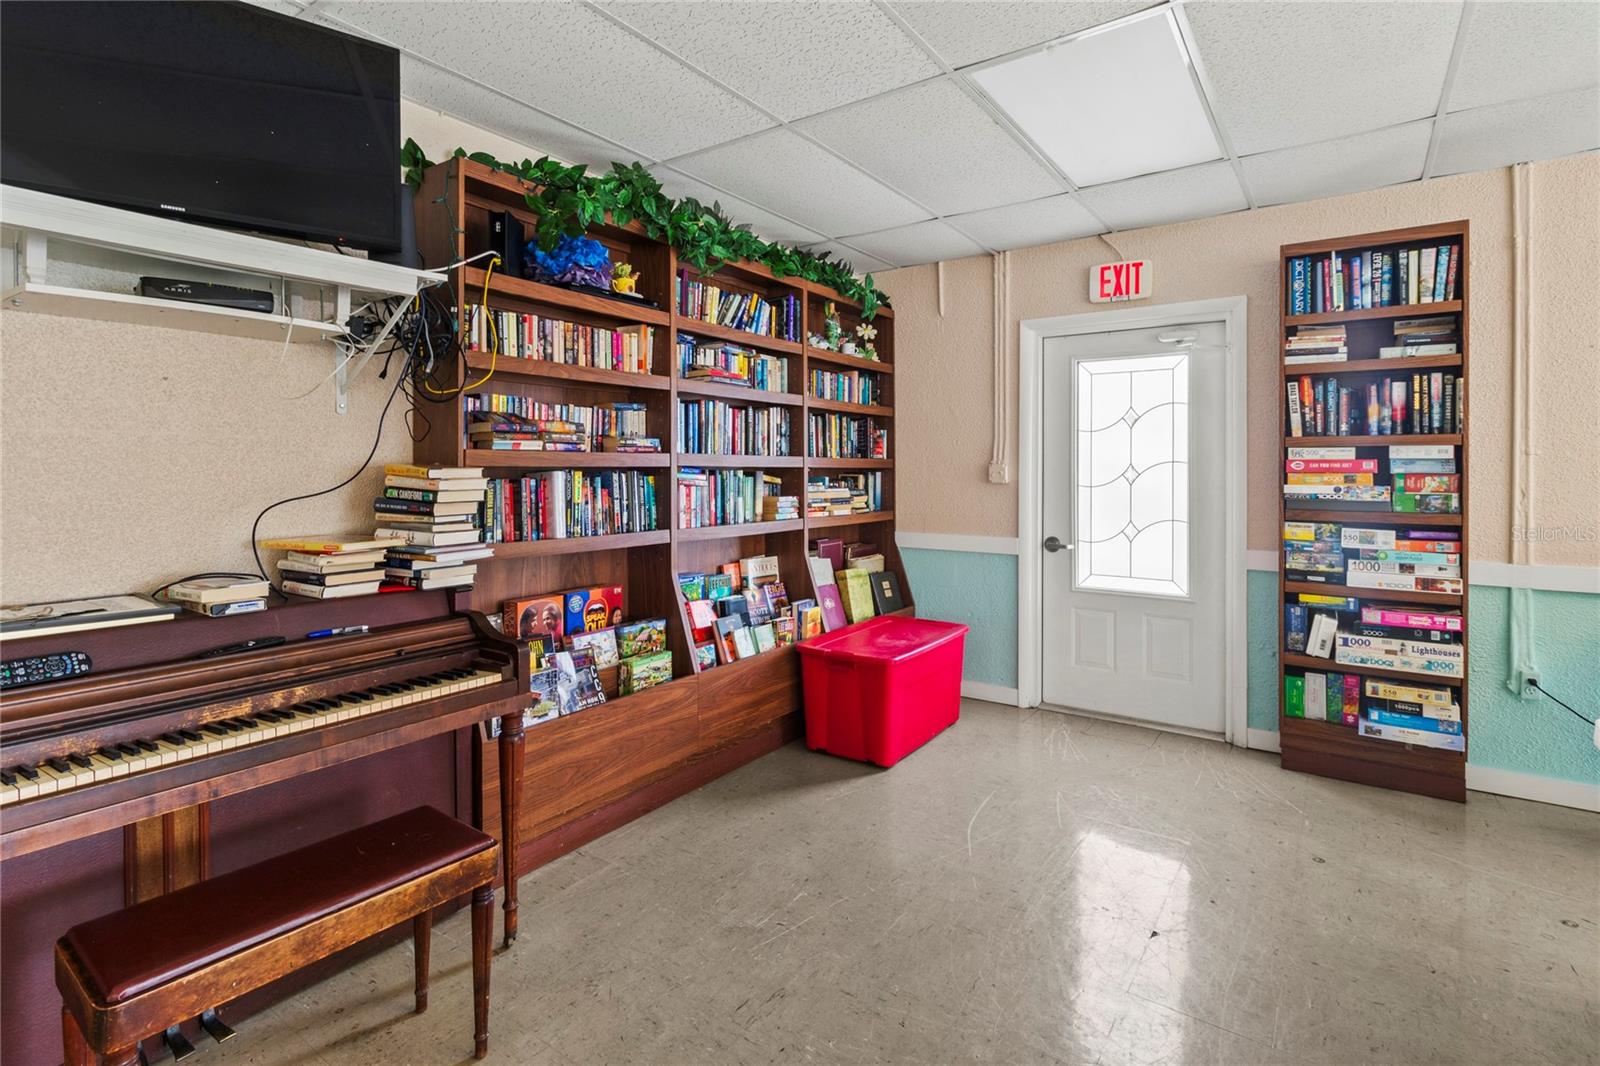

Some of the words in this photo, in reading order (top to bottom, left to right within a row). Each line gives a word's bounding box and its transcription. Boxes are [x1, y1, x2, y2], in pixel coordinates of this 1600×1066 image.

[1100, 261, 1143, 298] EXIT
[1293, 259, 1305, 313] DICTIONARY
[164, 286, 192, 294] ARRIS
[1291, 397, 1299, 414] TAYLOR
[1351, 561, 1381, 572] 1000
[1384, 582, 1413, 590] 1000
[587, 612, 606, 622] SPEAK
[587, 620, 606, 633] OUT
[528, 640, 544, 654] OHN
[1338, 636, 1371, 648] 1000
[1411, 645, 1461, 658] Lighthouses
